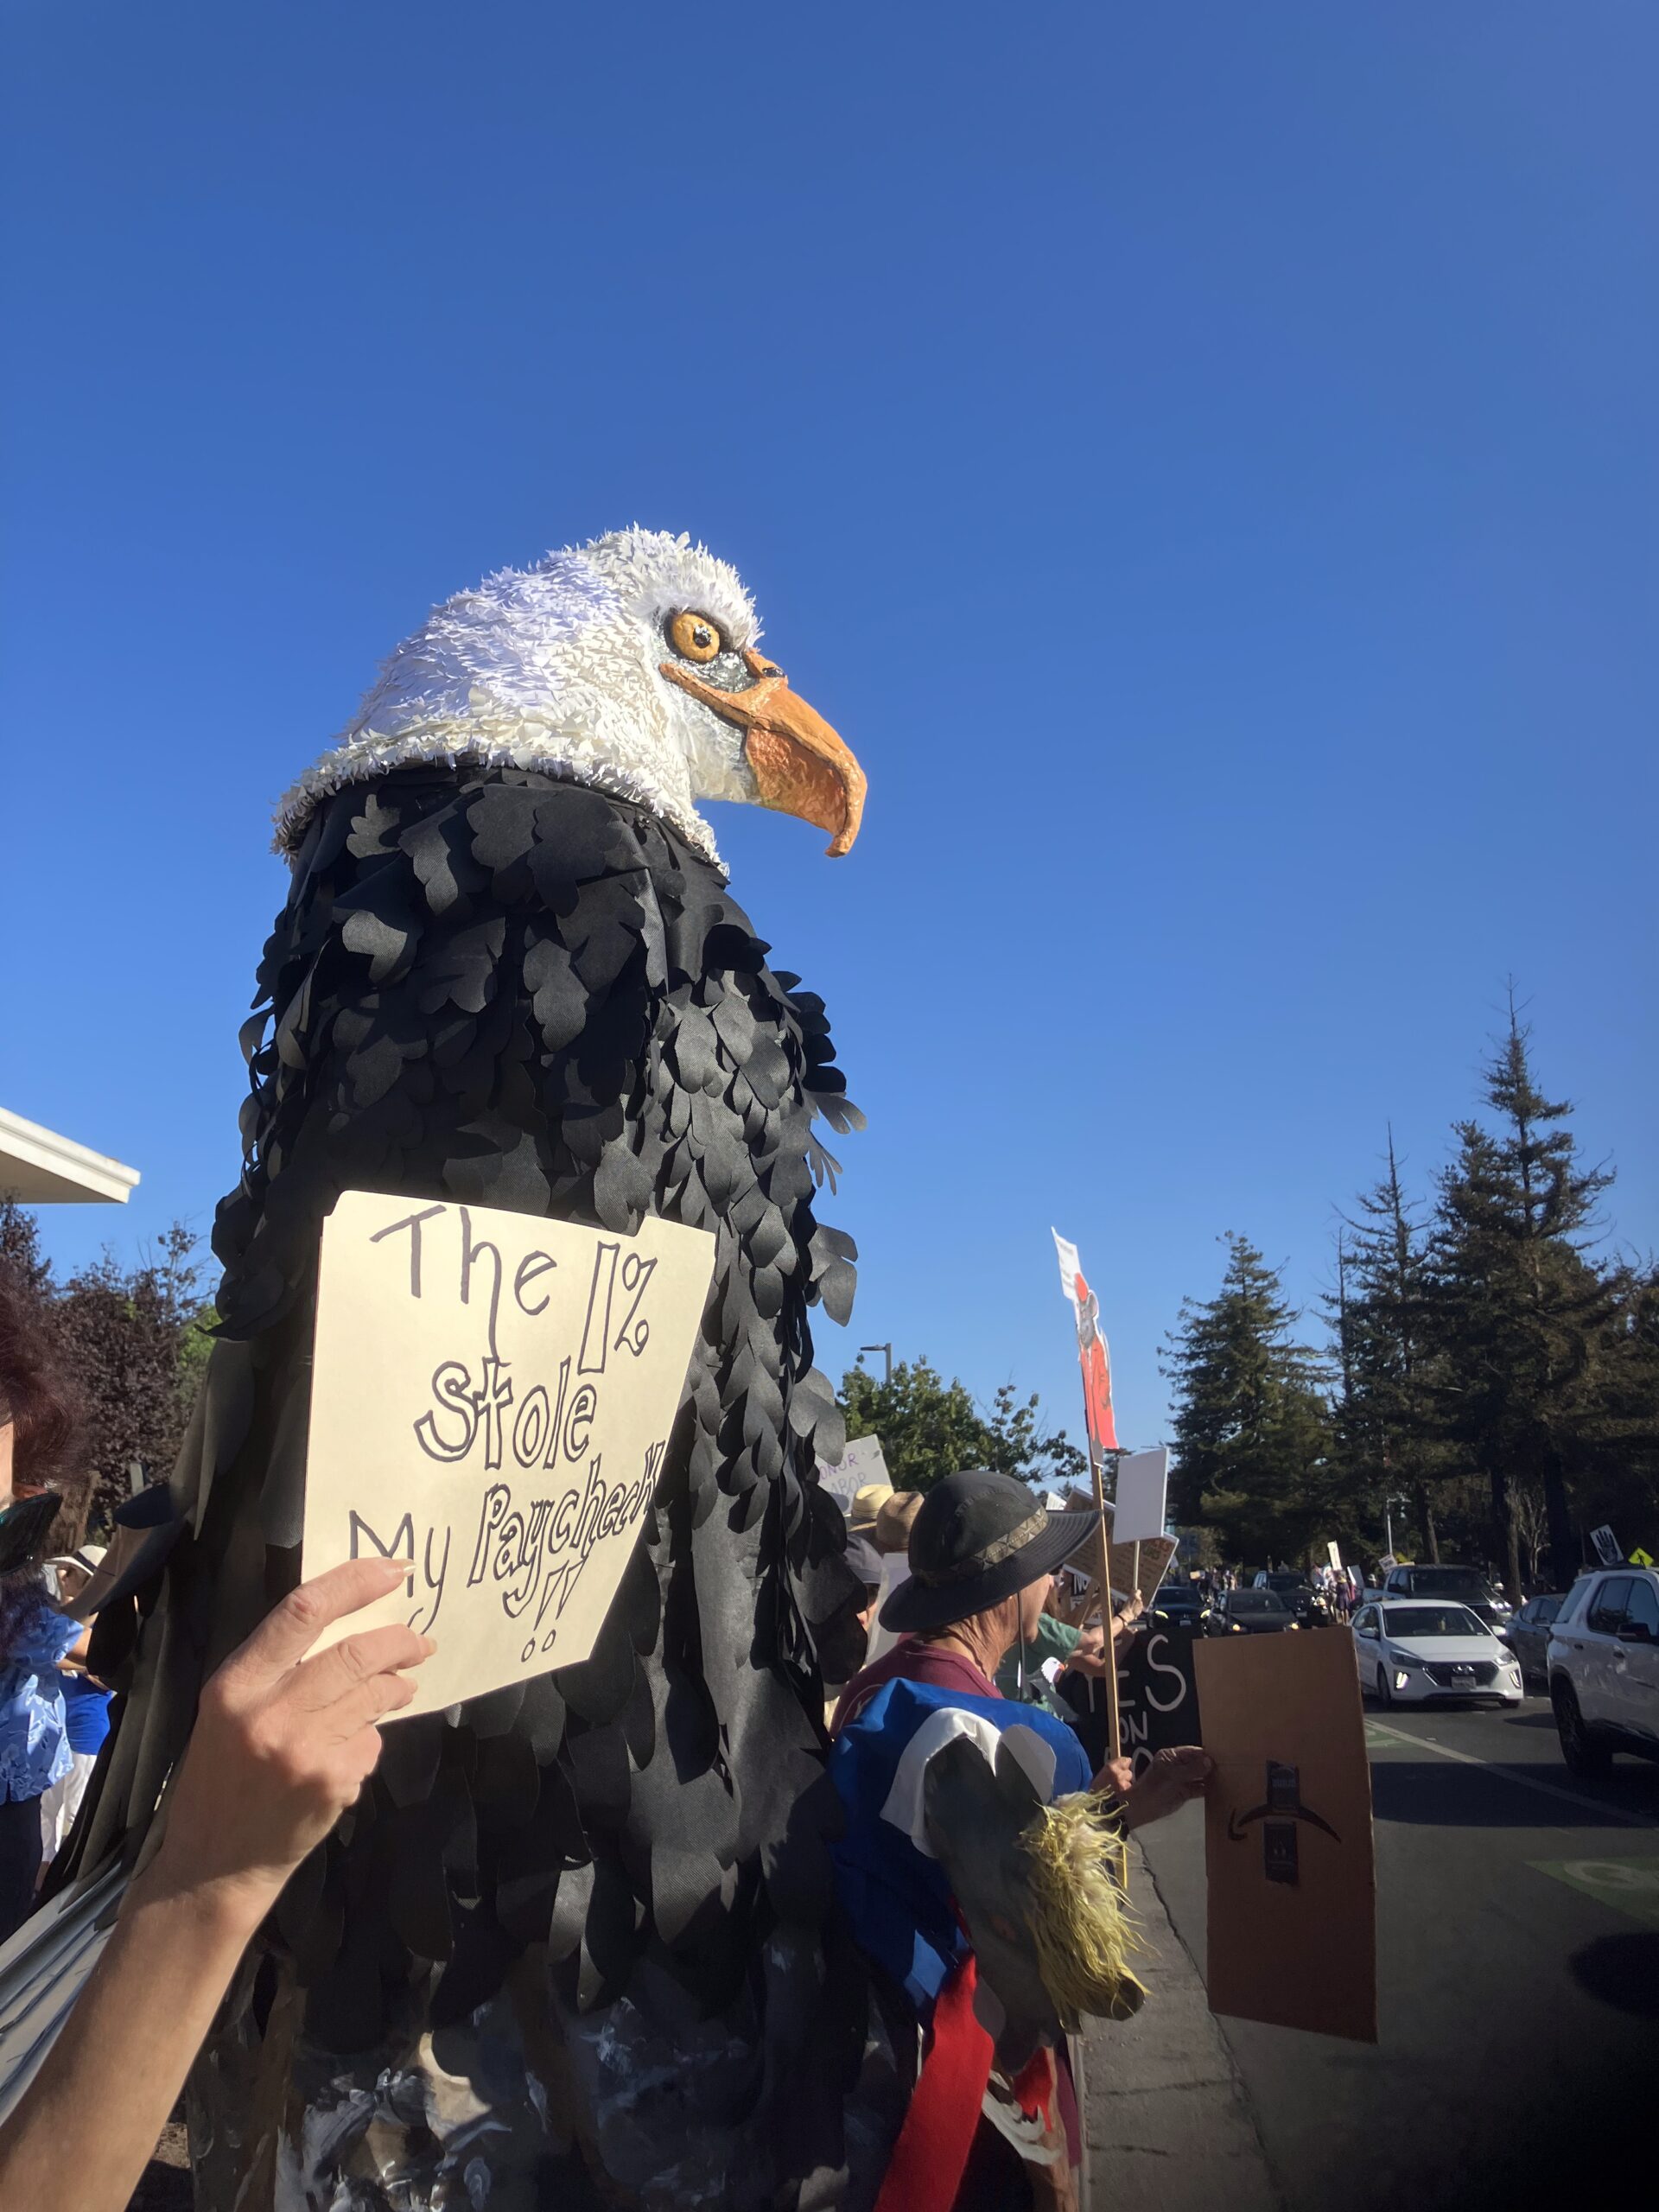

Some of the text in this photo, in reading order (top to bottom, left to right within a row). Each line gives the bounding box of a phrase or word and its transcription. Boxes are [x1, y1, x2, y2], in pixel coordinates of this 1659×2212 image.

[370, 1205, 658, 1375] The 1%
[413, 1356, 598, 1470] Stole
[819, 1452, 859, 1480] ONOR
[348, 1510, 451, 1636] My
